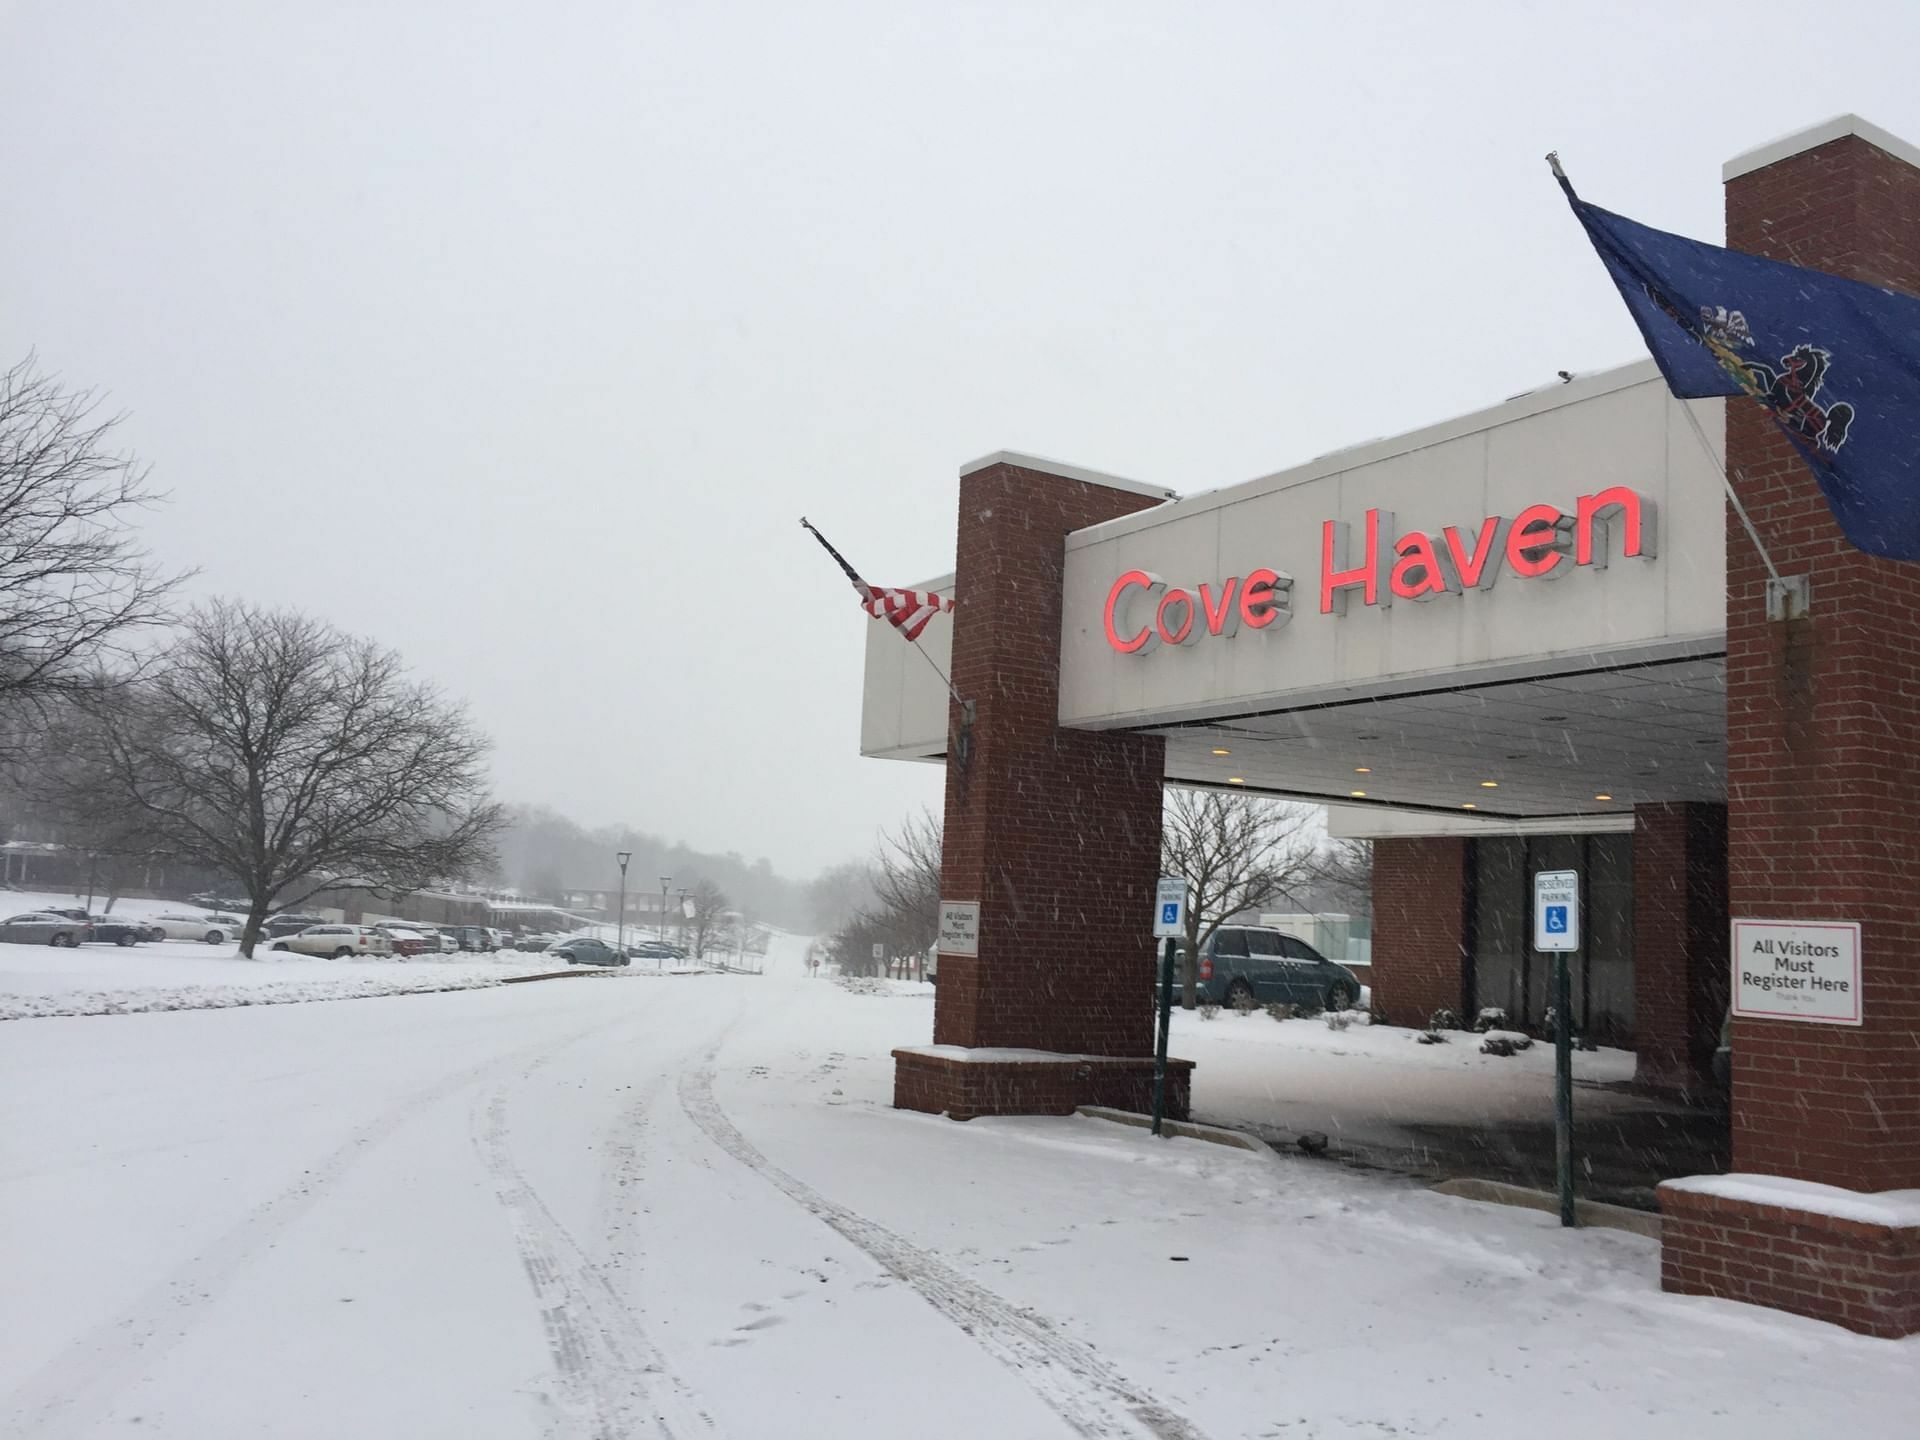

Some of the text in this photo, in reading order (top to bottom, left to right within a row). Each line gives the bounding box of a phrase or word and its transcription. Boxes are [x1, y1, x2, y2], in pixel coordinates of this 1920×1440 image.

[1103, 486, 1643, 654] Cove Haven
[1537, 879, 1575, 889] RESERVED
[1541, 891, 1572, 902] PARKING
[1752, 939, 1839, 958] All Visitors
[1775, 957, 1815, 973] Must
[1742, 971, 1849, 992] Register Here
